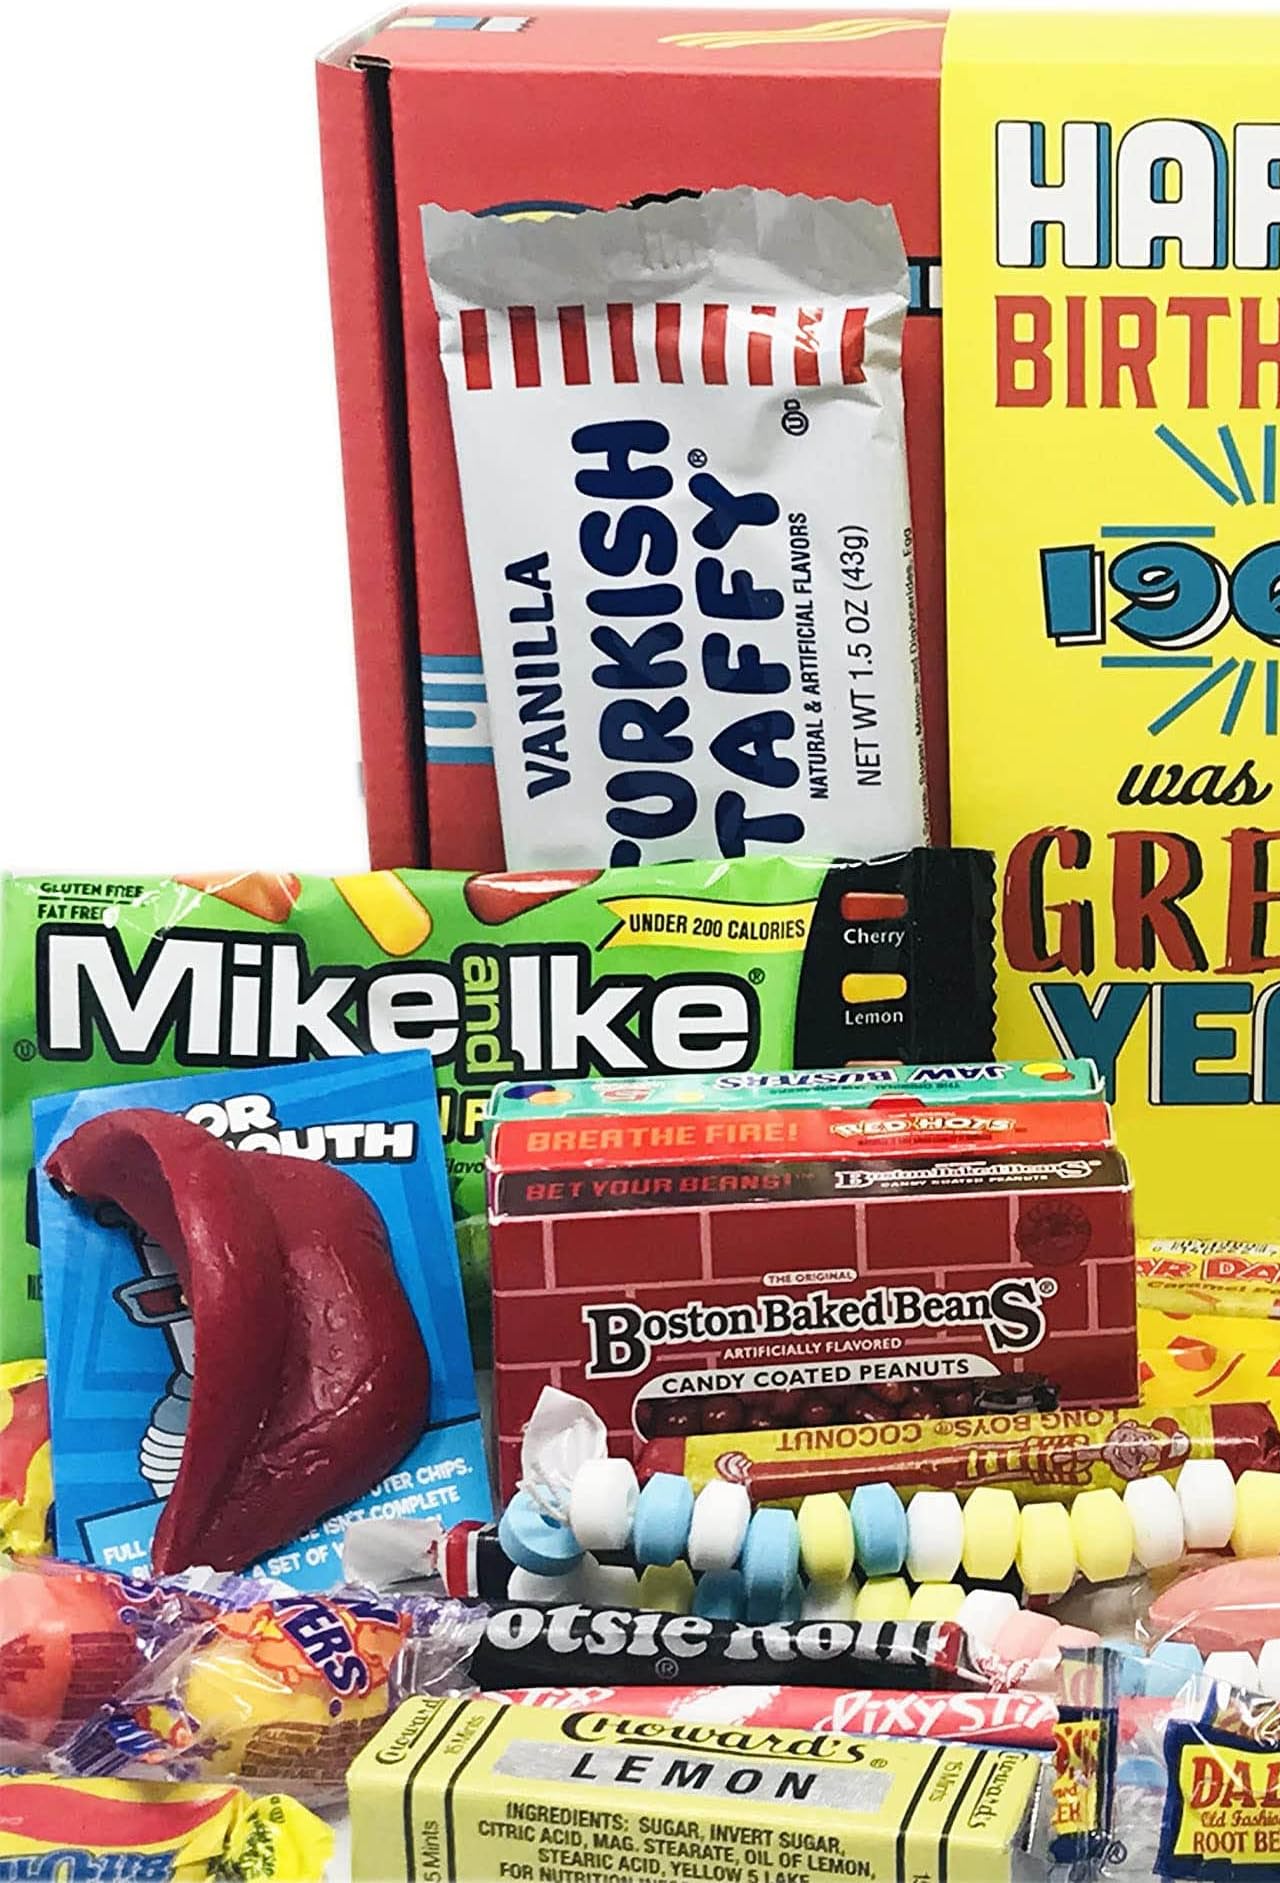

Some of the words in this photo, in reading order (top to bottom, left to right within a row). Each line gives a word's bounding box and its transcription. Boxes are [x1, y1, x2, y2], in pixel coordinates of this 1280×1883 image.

[788, 512, 812, 594] FLAVORS
[837, 526, 872, 591] (43g)
[845, 600, 870, 634] OZ
[795, 600, 820, 695] ARTIFICIAL
[848, 643, 873, 680] 1.5
[505, 551, 571, 799] VANILLA
[688, 472, 806, 858] TAFFY
[804, 701, 822, 713] &
[850, 688, 877, 730] WT
[806, 719, 829, 800] NATURAL
[854, 737, 882, 787] NET
[1116, 757, 1274, 806] was
[40, 882, 102, 896] GLUTEN
[37, 904, 68, 919] FAT
[629, 913, 688, 933] UNDER
[692, 918, 722, 937] 200
[727, 918, 805, 940] CALORIES
[843, 928, 905, 947] Cherry
[48, 934, 459, 1058] Mike
[463, 955, 502, 1074] and
[509, 955, 750, 1071] Ike
[845, 1010, 904, 1025] Lemon
[912, 1065, 1010, 1082] JAW
[228, 1122, 414, 1162] OUTH
[526, 1124, 697, 1152] BREATHE
[706, 1122, 798, 1145] FIRE!
[526, 1181, 582, 1201] BET
[591, 1177, 673, 1198] YOUR
[679, 1173, 792, 1193] BEANS!
[768, 1275, 793, 1284] THE
[796, 1271, 853, 1283] ORIGINAL
[587, 1302, 756, 1375] Boston
[762, 1291, 887, 1333] Baked
[724, 1342, 821, 1360] ARTIFICIALLY
[826, 1337, 902, 1353] FLAVORED
[662, 1373, 745, 1394] CANDY
[754, 1366, 851, 1388] COATED
[860, 1359, 969, 1380] PEANUTS
[775, 1423, 922, 1452] COCONUT
[953, 1413, 1031, 1438] BOYS
[416, 1457, 473, 1485] CHIPS.
[370, 1485, 461, 1520] COMPLETE
[103, 1540, 146, 1565] FULL
[267, 1552, 301, 1577] SET
[306, 1546, 330, 1567] OF
[570, 1752, 818, 1800] LEMON
[506, 1801, 629, 1832] INGREDIENTS:
[639, 1816, 705, 1842] SUGAR,
[710, 1823, 774, 1848] INVERT
[779, 1831, 846, 1857] SUGAR,
[1201, 1811, 1225, 1828] Old
[421, 1820, 440, 1869] Mints
[478, 1820, 536, 1842] CITRIC
[540, 1827, 588, 1850] ACID,
[593, 1833, 640, 1852] MAG.
[643, 1838, 740, 1866] STEARATE,
[744, 1848, 774, 1867] OIL
[779, 1852, 803, 1869] OF
[807, 1854, 876, 1880] LEMON,
[1193, 1831, 1248, 1854] ROOT
[500, 1862, 533, 1880] FOR
[538, 1848, 614, 1870] STEARIC
[618, 1856, 666, 1878] ACID,
[670, 1861, 742, 1883] YELLOW
[747, 1869, 759, 1883] 5
